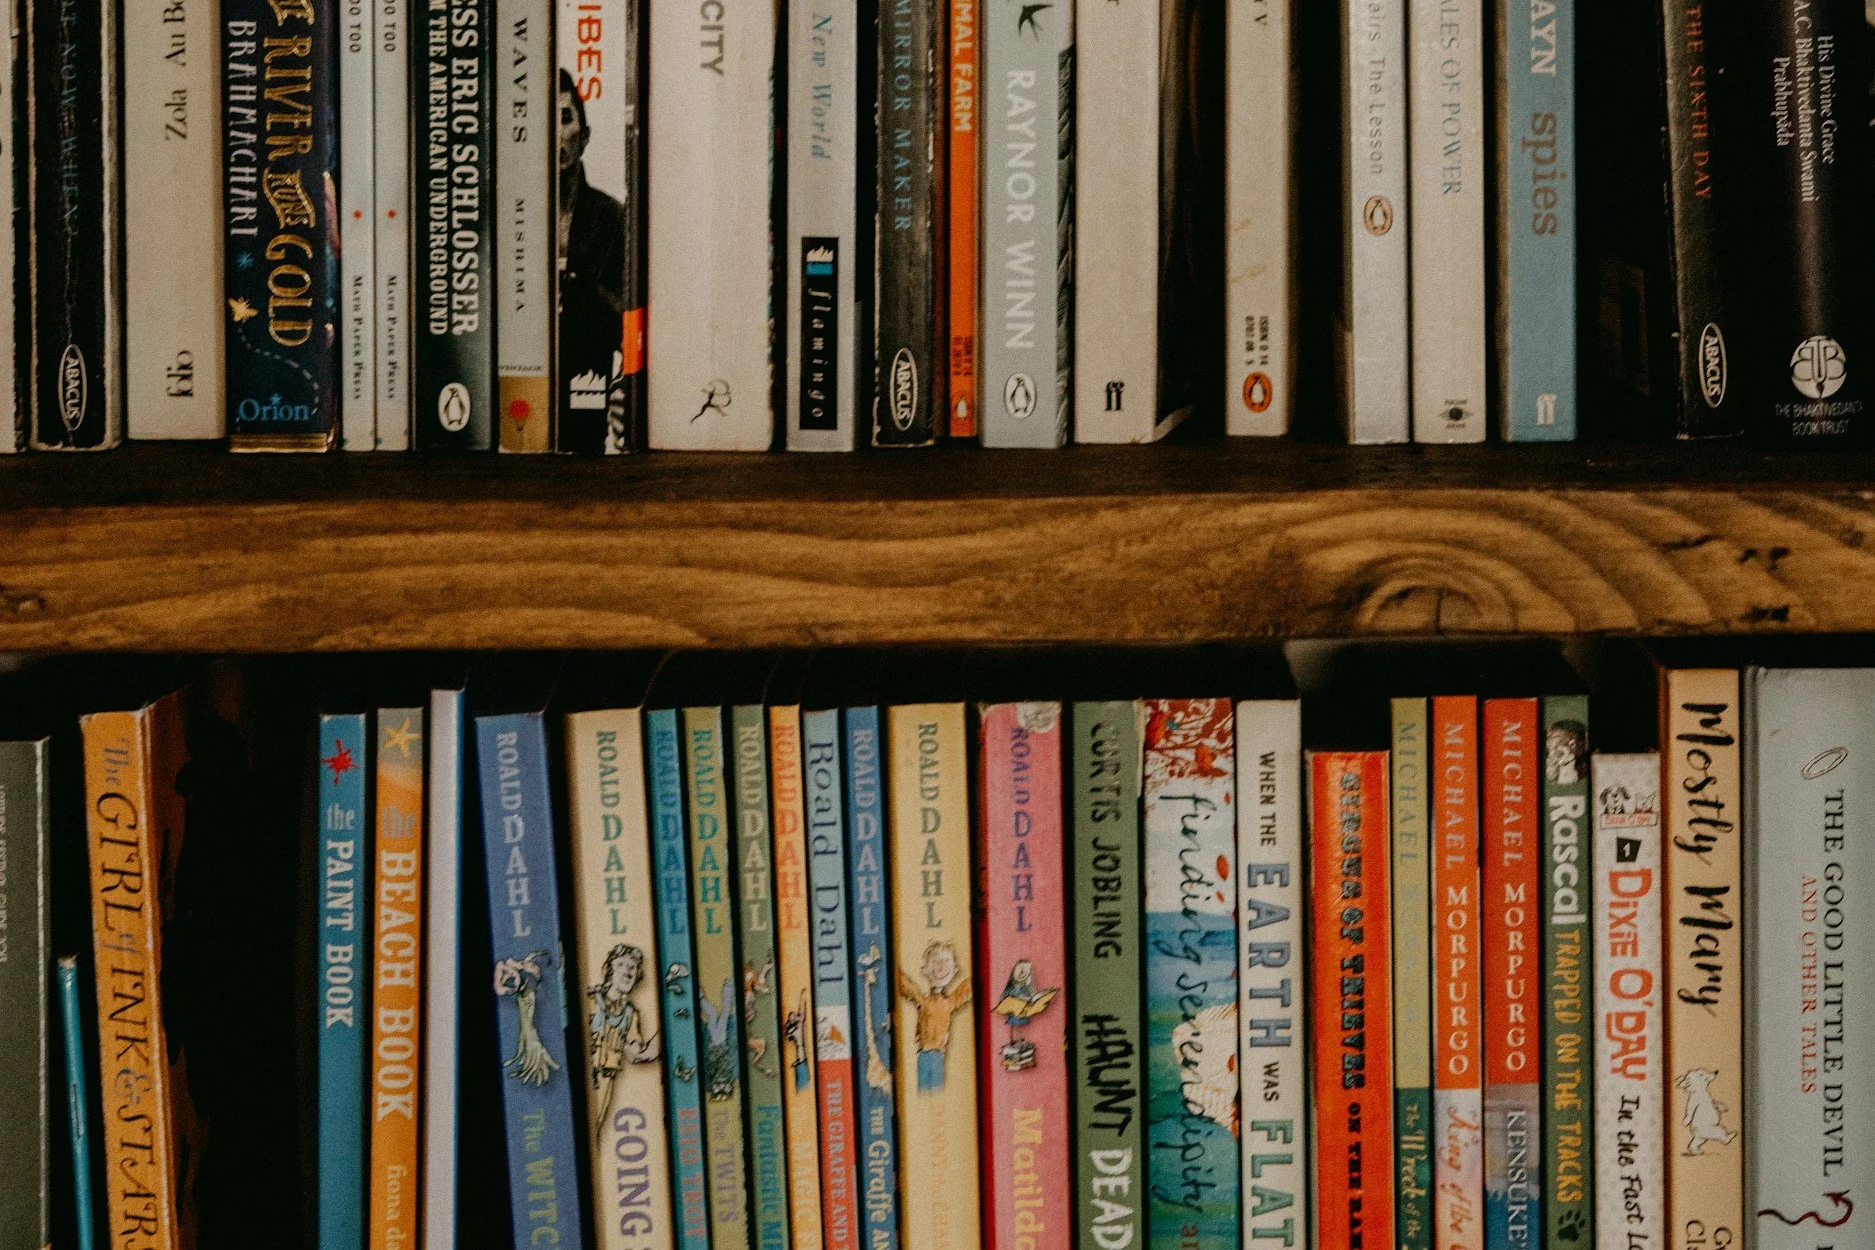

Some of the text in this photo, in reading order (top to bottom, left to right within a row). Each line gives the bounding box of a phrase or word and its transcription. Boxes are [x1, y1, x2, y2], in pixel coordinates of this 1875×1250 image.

[429, 16, 448, 57] THE
[451, 57, 479, 134] ERIC
[512, 17, 528, 144] WAVES
[700, 0, 725, 77] CITY
[811, 14, 832, 68] New
[1254, 15, 1267, 27] V
[1685, 6, 1703, 52] THE
[229, 20, 258, 236] BRAHMACHARI
[429, 61, 448, 170] AMERICAN
[811, 83, 832, 162] World
[955, 63, 973, 131] FARM
[1687, 63, 1708, 140] SIXTH
[1793, 0, 1820, 202] A.C. Bhaktivedanta Swami
[1818, 35, 1838, 164] His Divine Grace
[451, 144, 479, 335] SCHLOSSER
[893, 130, 913, 231] MAKER
[1005, 69, 1036, 350] RAYNOR WINN
[1521, 111, 1568, 236] spies
[1691, 151, 1712, 199] DAY
[429, 178, 448, 335] UNDERGROUND
[514, 197, 525, 312] MISHIMA
[64, 356, 80, 419] ABACUS
[896, 360, 911, 420] ABACUS
[1704, 334, 1721, 398] ABACUS
[495, 732, 532, 937] ROALD DAHL
[596, 730, 627, 935] ROALD DAHL
[691, 729, 725, 935] ROALD DAHL
[738, 723, 769, 932] ROALD DAHL
[916, 722, 944, 929] ROALD DAHL
[1009, 727, 1035, 933] ROALD DAHL
[1090, 720, 1123, 961] CURTIS JOBLING
[1398, 720, 1419, 869] MICHAEL
[1672, 702, 1736, 1017] Mostly Mary
[325, 803, 355, 1028] the PAINT BOOK
[1443, 723, 1469, 1076] MICHAEL MORPURGO
[1502, 720, 1527, 1072] MICHAEL MORPURGO
[375, 807, 417, 1221] the BEACH BOOK fiona
[1247, 751, 1296, 1247] WHEN THE EARTH WAS FLAT
[1550, 794, 1588, 1203] Rascal TRAPPED ON THE TRACKS
[1800, 875, 1819, 1095] AND OTHER TALES
[1822, 789, 1846, 1178] THE GOOD LITTLE DEVIL
[612, 1106, 653, 1236] GOING
[756, 1106, 781, 1213] Fantastic
